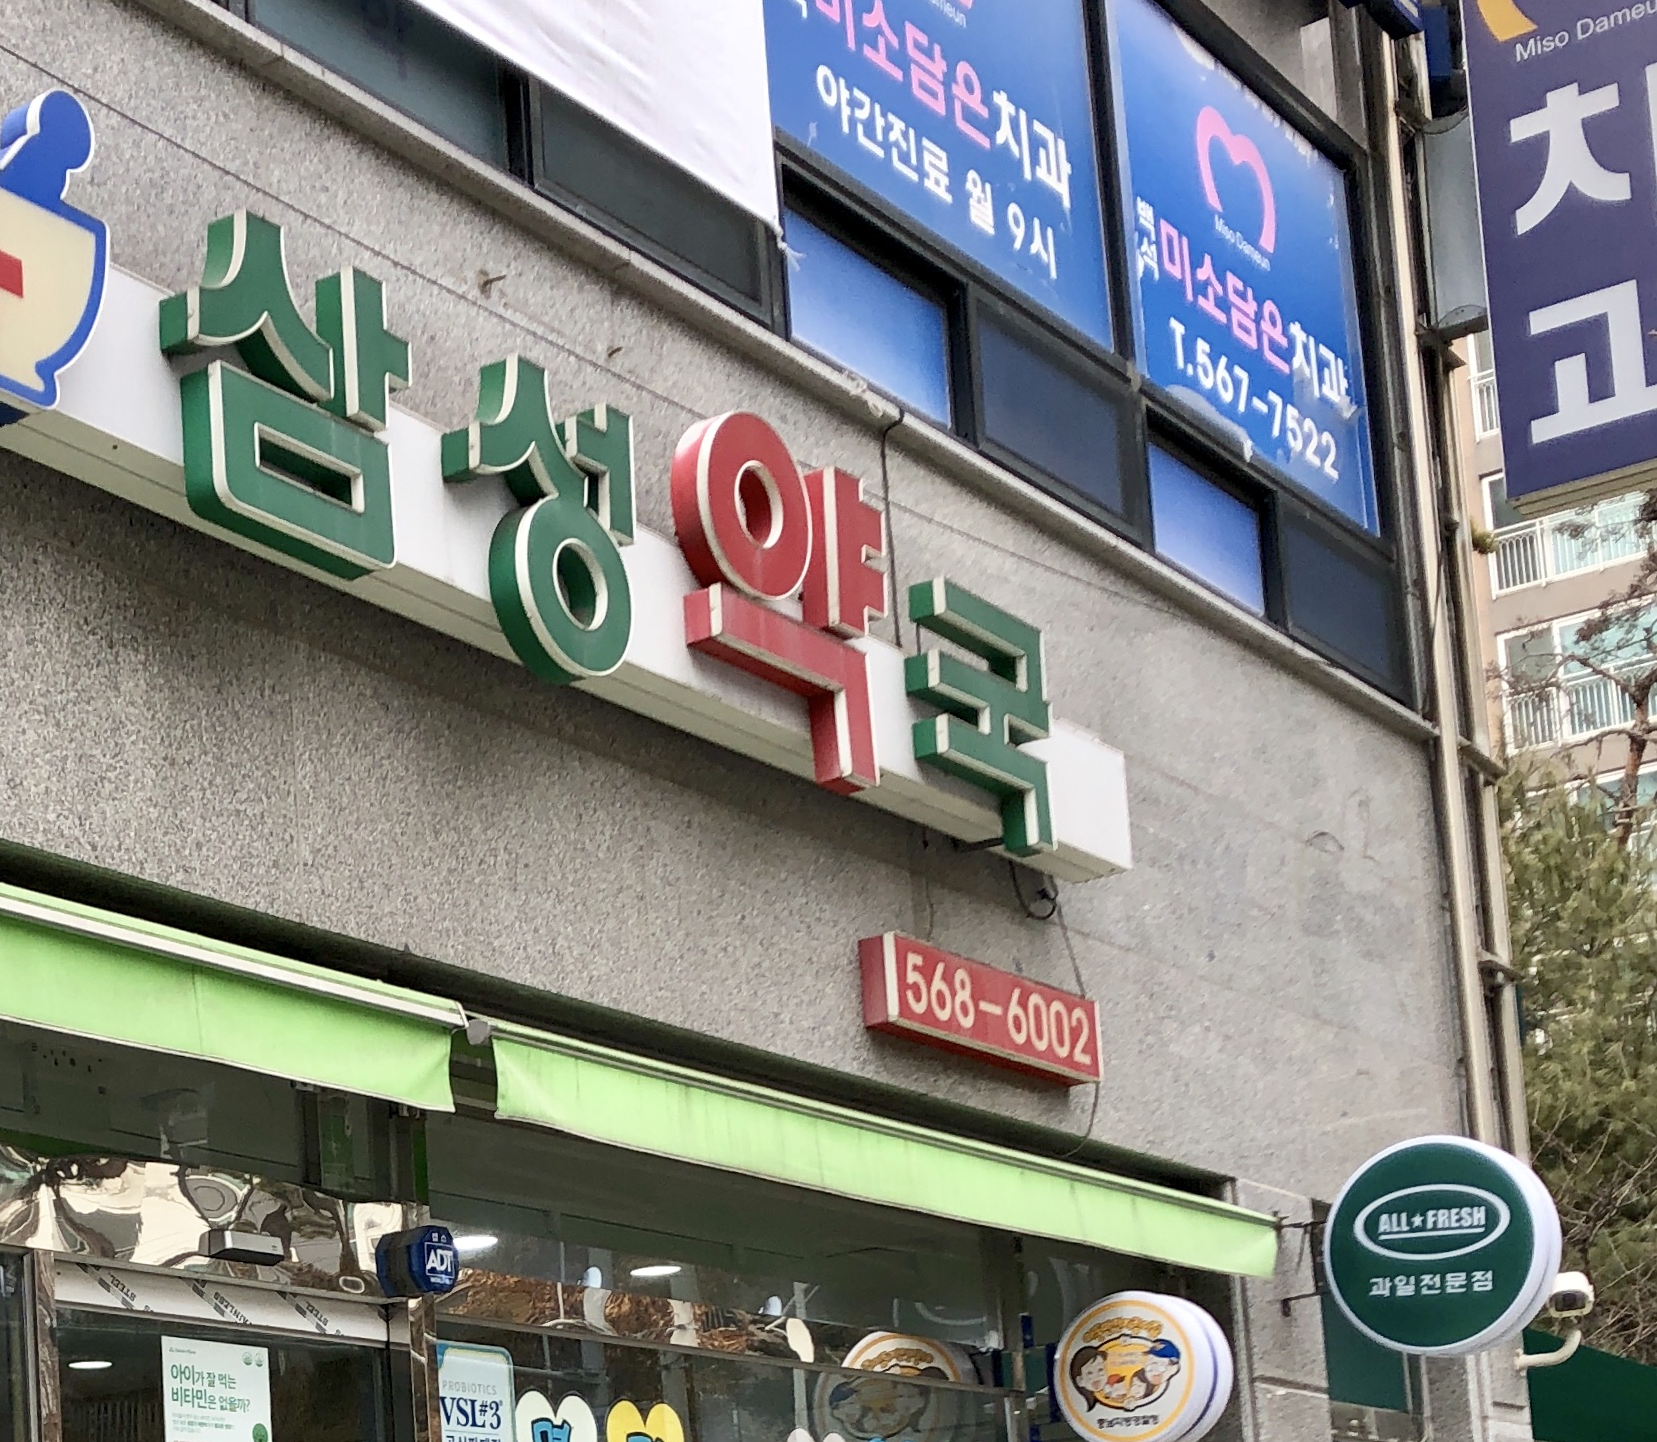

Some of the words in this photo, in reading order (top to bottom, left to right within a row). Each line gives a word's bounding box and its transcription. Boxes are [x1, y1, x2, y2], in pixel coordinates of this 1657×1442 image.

[1515, 29, 1569, 63] Miso
[816, 64, 953, 204] 야간진료
[966, 168, 995, 236] 월
[1006, 202, 1058, 280] 9시
[1159, 218, 1354, 420] 미소담은치과
[1169, 316, 1339, 483] T.567-7522
[159, 208, 1054, 858] 삼성약국
[905, 948, 1094, 1067] 568-6002
[1425, 1205, 1487, 1231] FRESH
[426, 1247, 455, 1278] ADT
[1369, 1270, 1494, 1298] 과일전문점
[170, 1363, 205, 1386] 아이가
[206, 1371, 216, 1388] 잘
[217, 1373, 237, 1390] 먹는
[442, 1380, 497, 1396] PROBIOTICS
[171, 1386, 217, 1410] 비타민은
